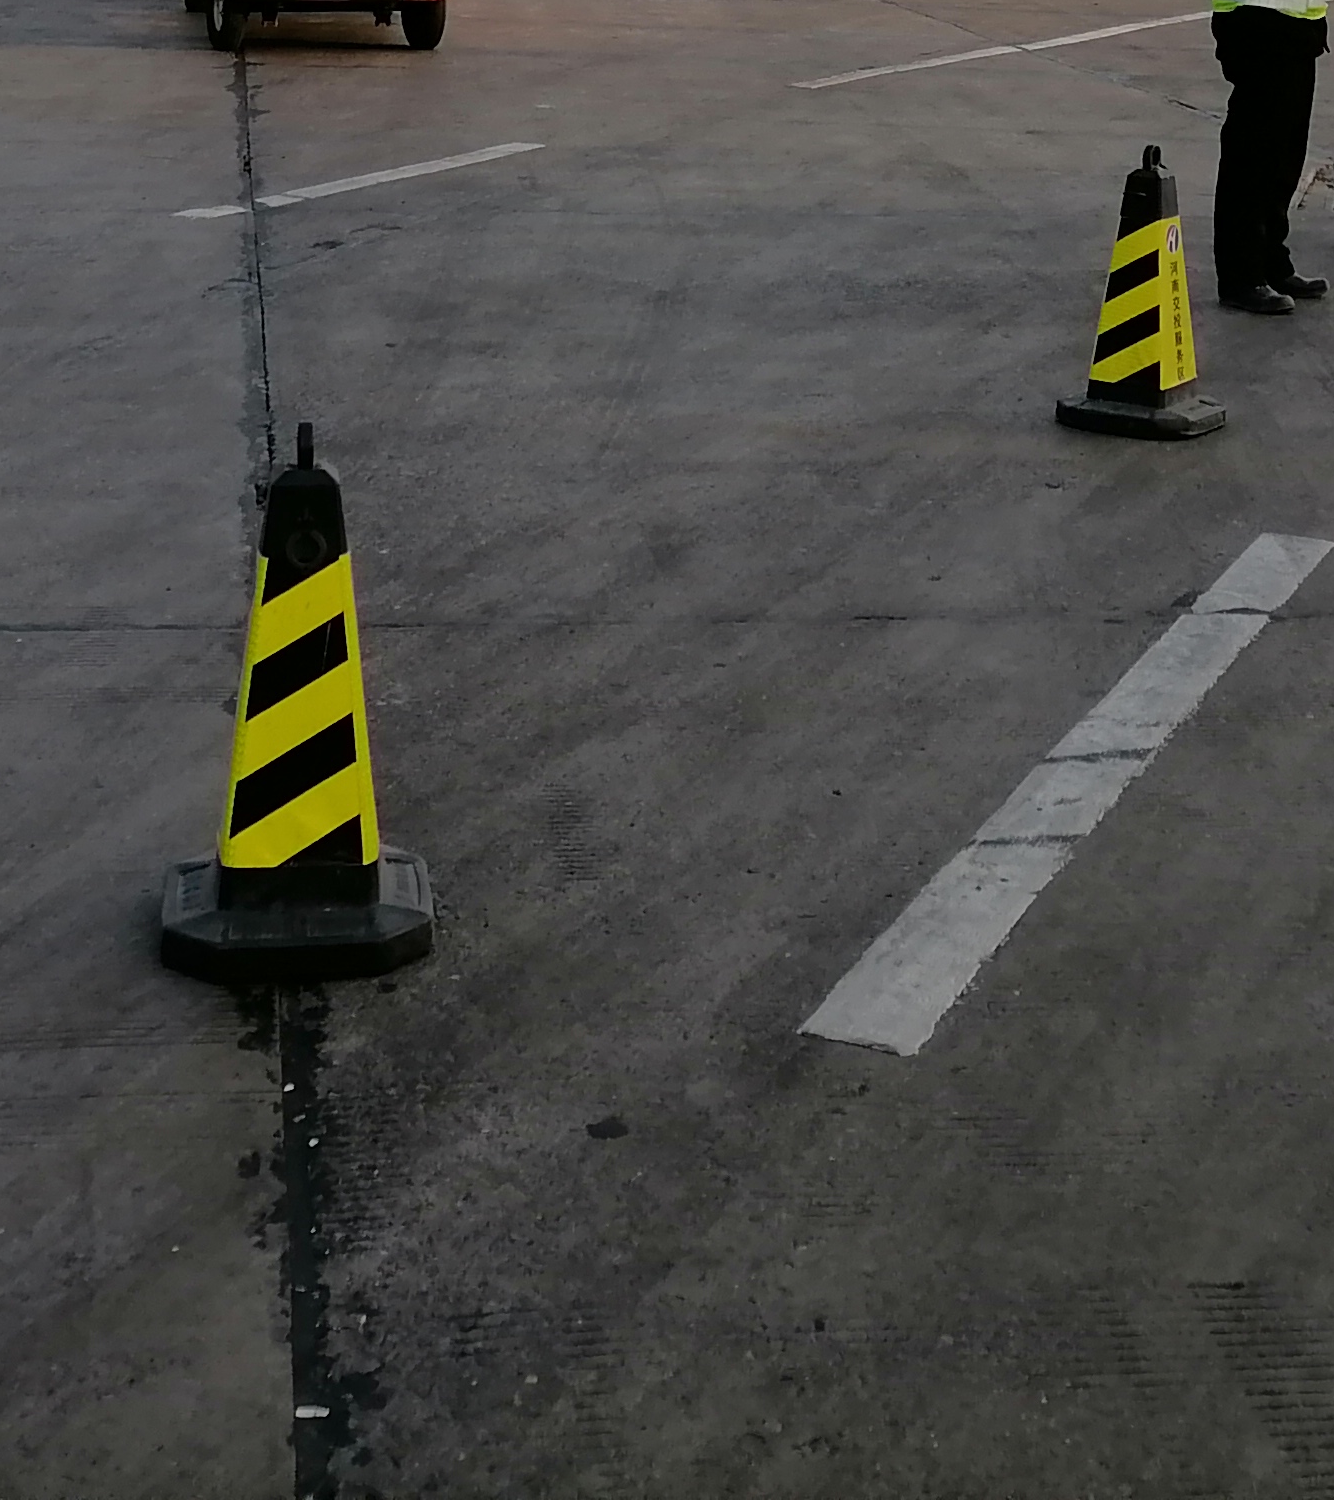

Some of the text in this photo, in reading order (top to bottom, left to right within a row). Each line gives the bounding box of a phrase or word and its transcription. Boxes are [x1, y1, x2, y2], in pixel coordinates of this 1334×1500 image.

[1169, 261, 1186, 382] 河南交投服务区
